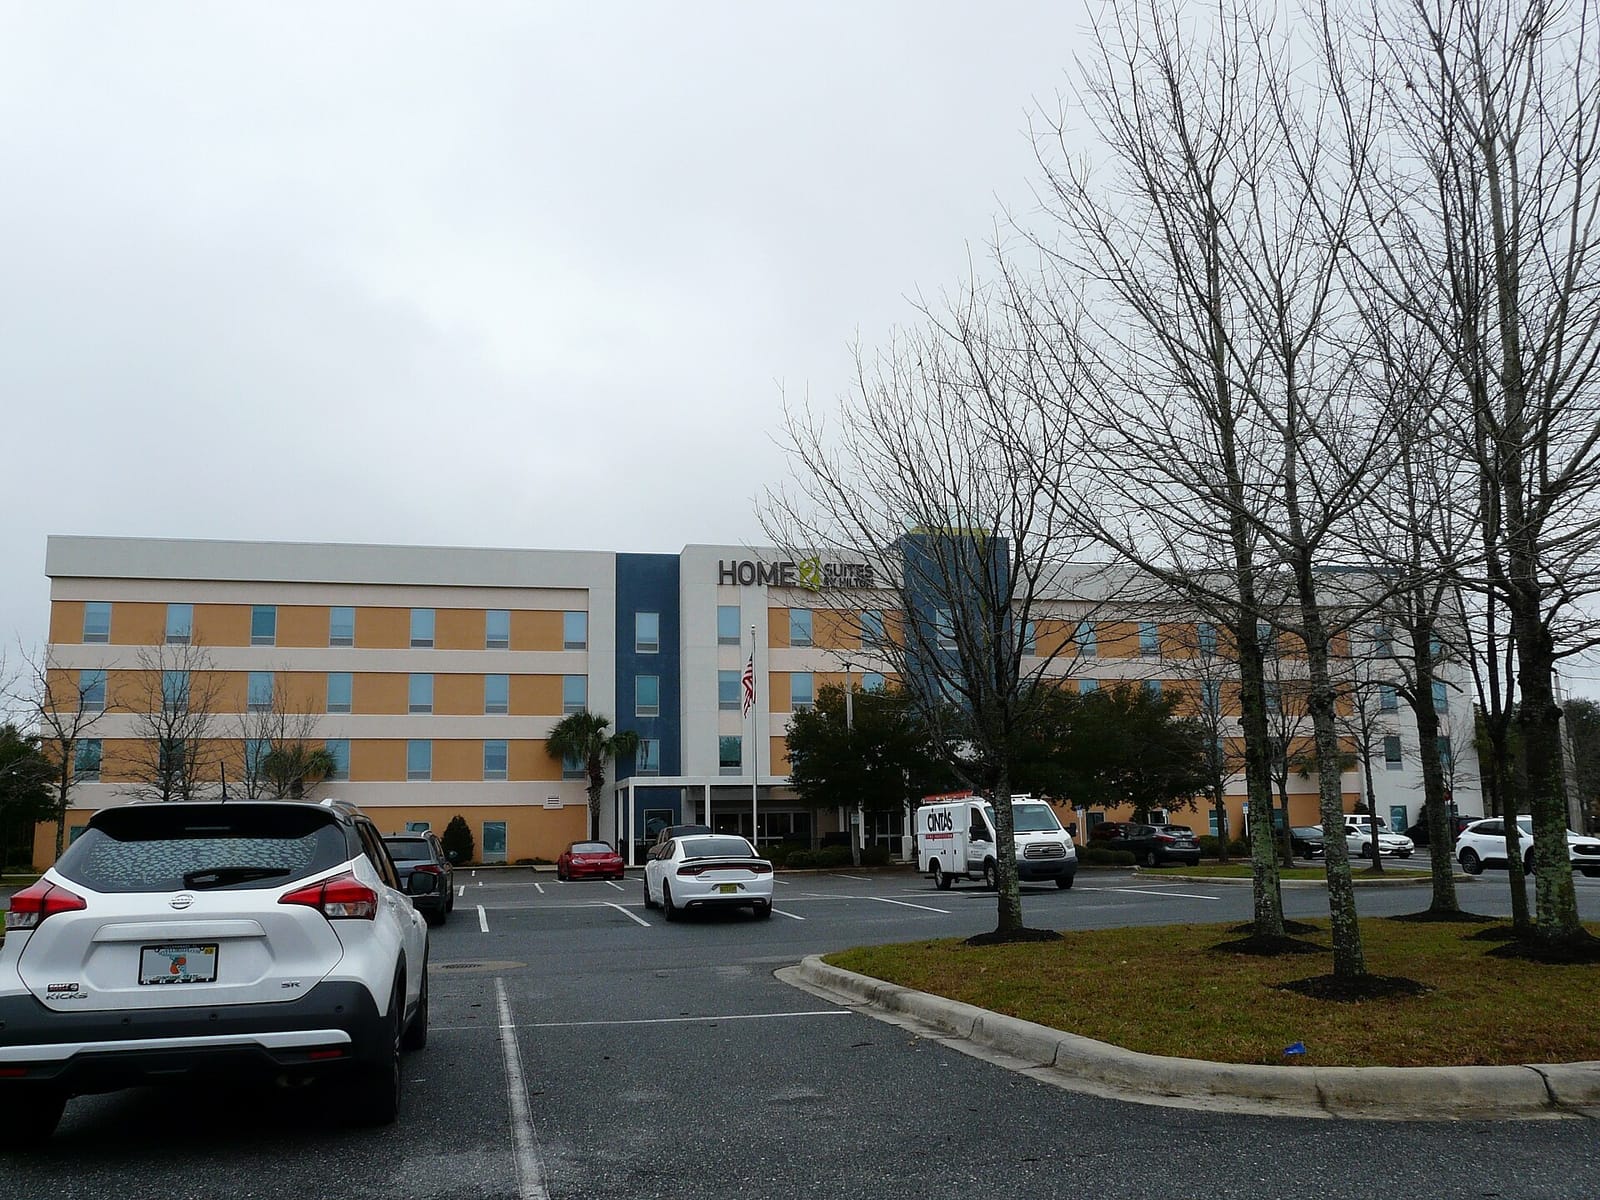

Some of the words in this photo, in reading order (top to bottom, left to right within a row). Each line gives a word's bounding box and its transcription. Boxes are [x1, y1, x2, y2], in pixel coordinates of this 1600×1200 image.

[718, 559, 797, 587] HOME
[823, 562, 874, 578] SUITES
[45, 991, 88, 1000] KICKS
